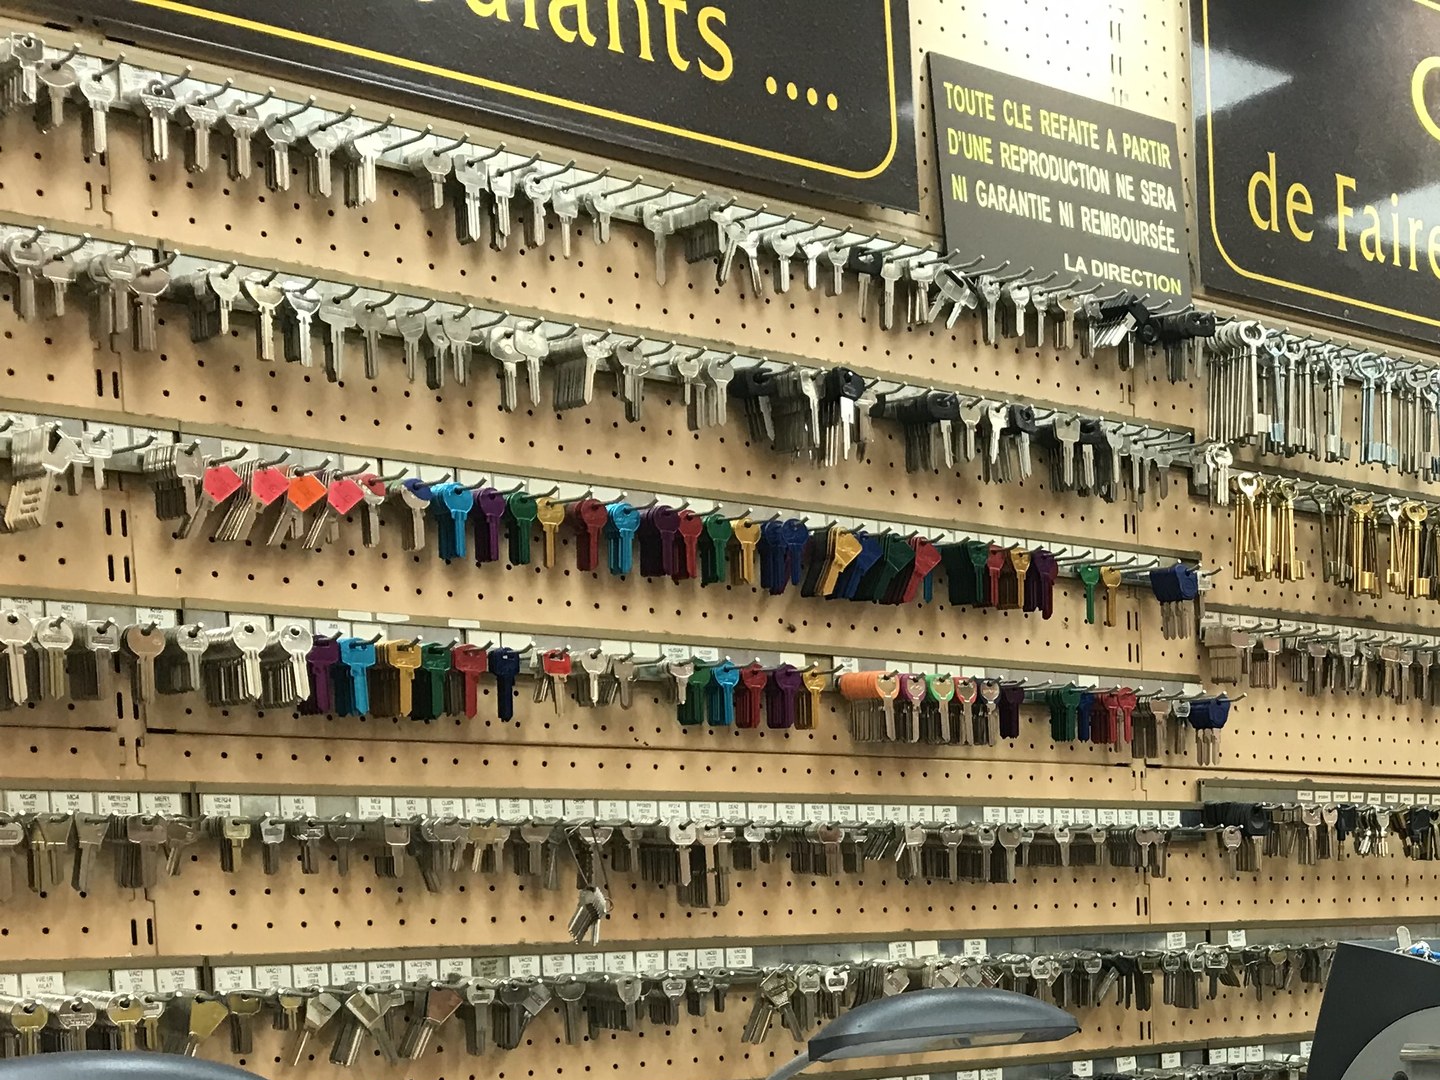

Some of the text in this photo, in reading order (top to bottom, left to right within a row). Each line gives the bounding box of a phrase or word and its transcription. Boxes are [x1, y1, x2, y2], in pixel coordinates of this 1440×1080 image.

[944, 81, 1172, 170] TOUTE CLE REFAITE A PARTIR
[947, 127, 1177, 213] D'UNE REPRODUCTION NE SERA
[1247, 151, 1315, 243] de
[951, 173, 1180, 254] NI GARANTIE NI REMBOURSÉE.
[1064, 253, 1182, 296] LA DIRECTION
